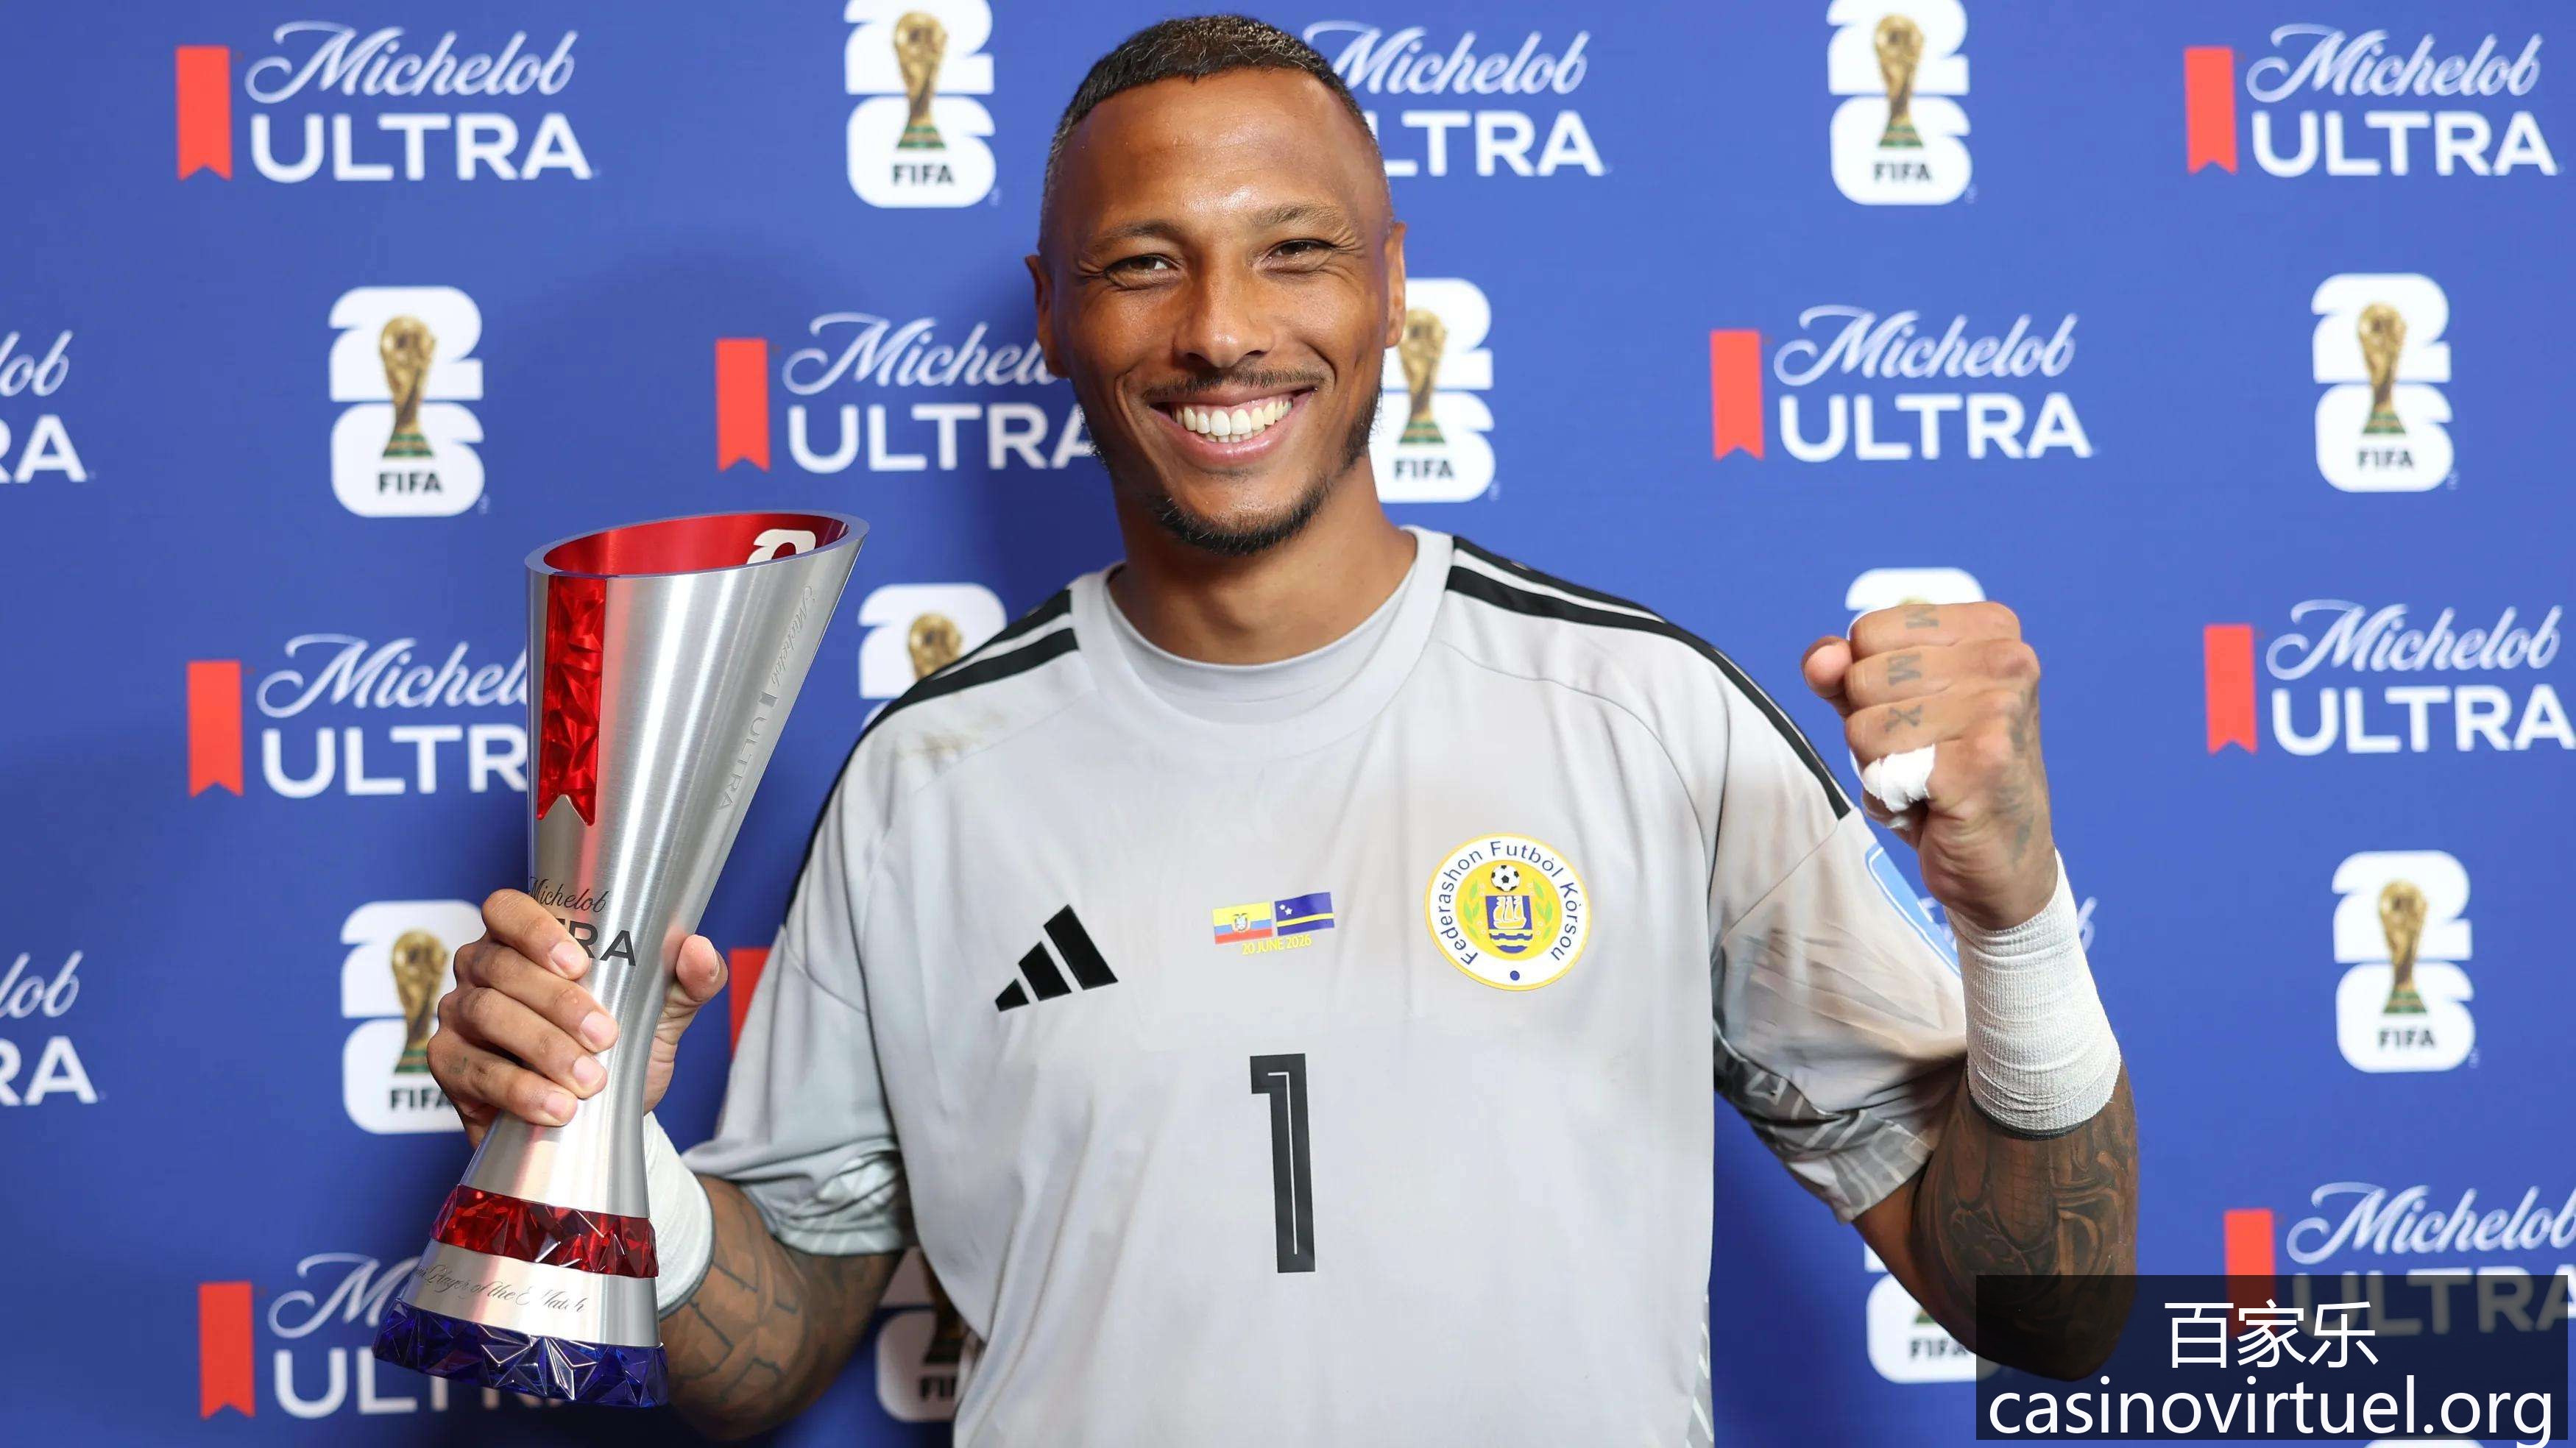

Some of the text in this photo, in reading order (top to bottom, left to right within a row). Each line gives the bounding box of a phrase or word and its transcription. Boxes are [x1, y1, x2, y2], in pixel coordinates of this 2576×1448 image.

[245, 21, 578, 104] Michelob
[1303, 20, 1590, 94] Michelob
[2246, 23, 2544, 103] Michelob
[250, 113, 593, 183] ULTRA
[891, 163, 955, 185] FIFA
[1363, 110, 1604, 177] TRA
[1873, 161, 1932, 182] FIFA
[2251, 111, 2558, 177] ULTRA
[783, 312, 1058, 395] Michel
[1773, 304, 2078, 386] Michelob
[1779, 392, 2092, 463] ULTRA
[2357, 448, 2415, 469] FIFA
[377, 471, 443, 494] FIFA
[1393, 458, 1454, 480] FIFA
[256, 633, 527, 718] Michel
[2265, 599, 2563, 681] Michelob
[2271, 684, 2576, 756] ULTRA
[261, 723, 528, 798] ULTR
[721, 716, 767, 809] ULTRA
[1438, 850, 1484, 965] Federashon
[1242, 934, 1313, 955] 20 JUNE 2026
[2378, 1027, 2436, 1048] FIFA
[1250, 1053, 1315, 1273] 1
[2286, 1182, 2576, 1265] Michelob
[486, 1284, 517, 1301] the
